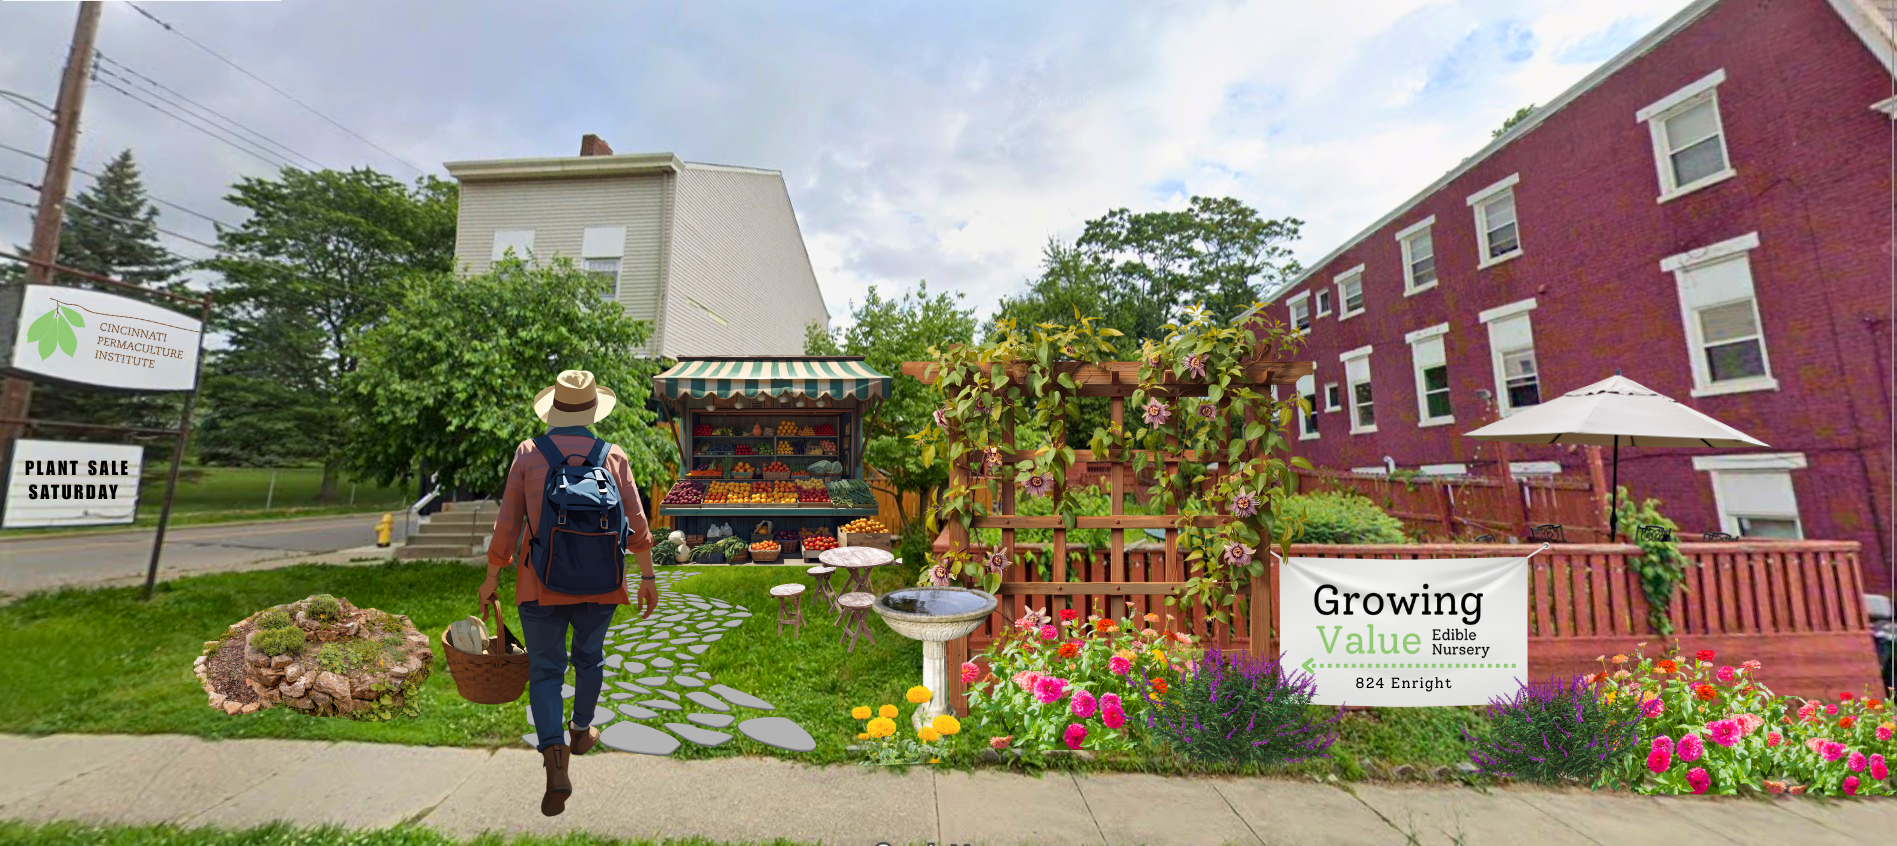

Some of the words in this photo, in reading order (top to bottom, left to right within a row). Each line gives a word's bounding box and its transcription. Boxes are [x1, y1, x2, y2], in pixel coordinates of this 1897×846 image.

[100, 322, 168, 343] CINCINNATI
[97, 336, 184, 360] PERMACULTURE
[94, 349, 156, 369] INSTITUTE
[25, 460, 78, 476] PLANT
[88, 460, 129, 476] SALE
[28, 484, 118, 500] SATURDAY
[1314, 583, 1483, 625] Growing
[1316, 623, 1421, 654] Value
[1432, 628, 1477, 641] Edible
[1432, 643, 1490, 658] Nursery
[1355, 677, 1385, 689] 824
[1391, 677, 1453, 692] Enright
